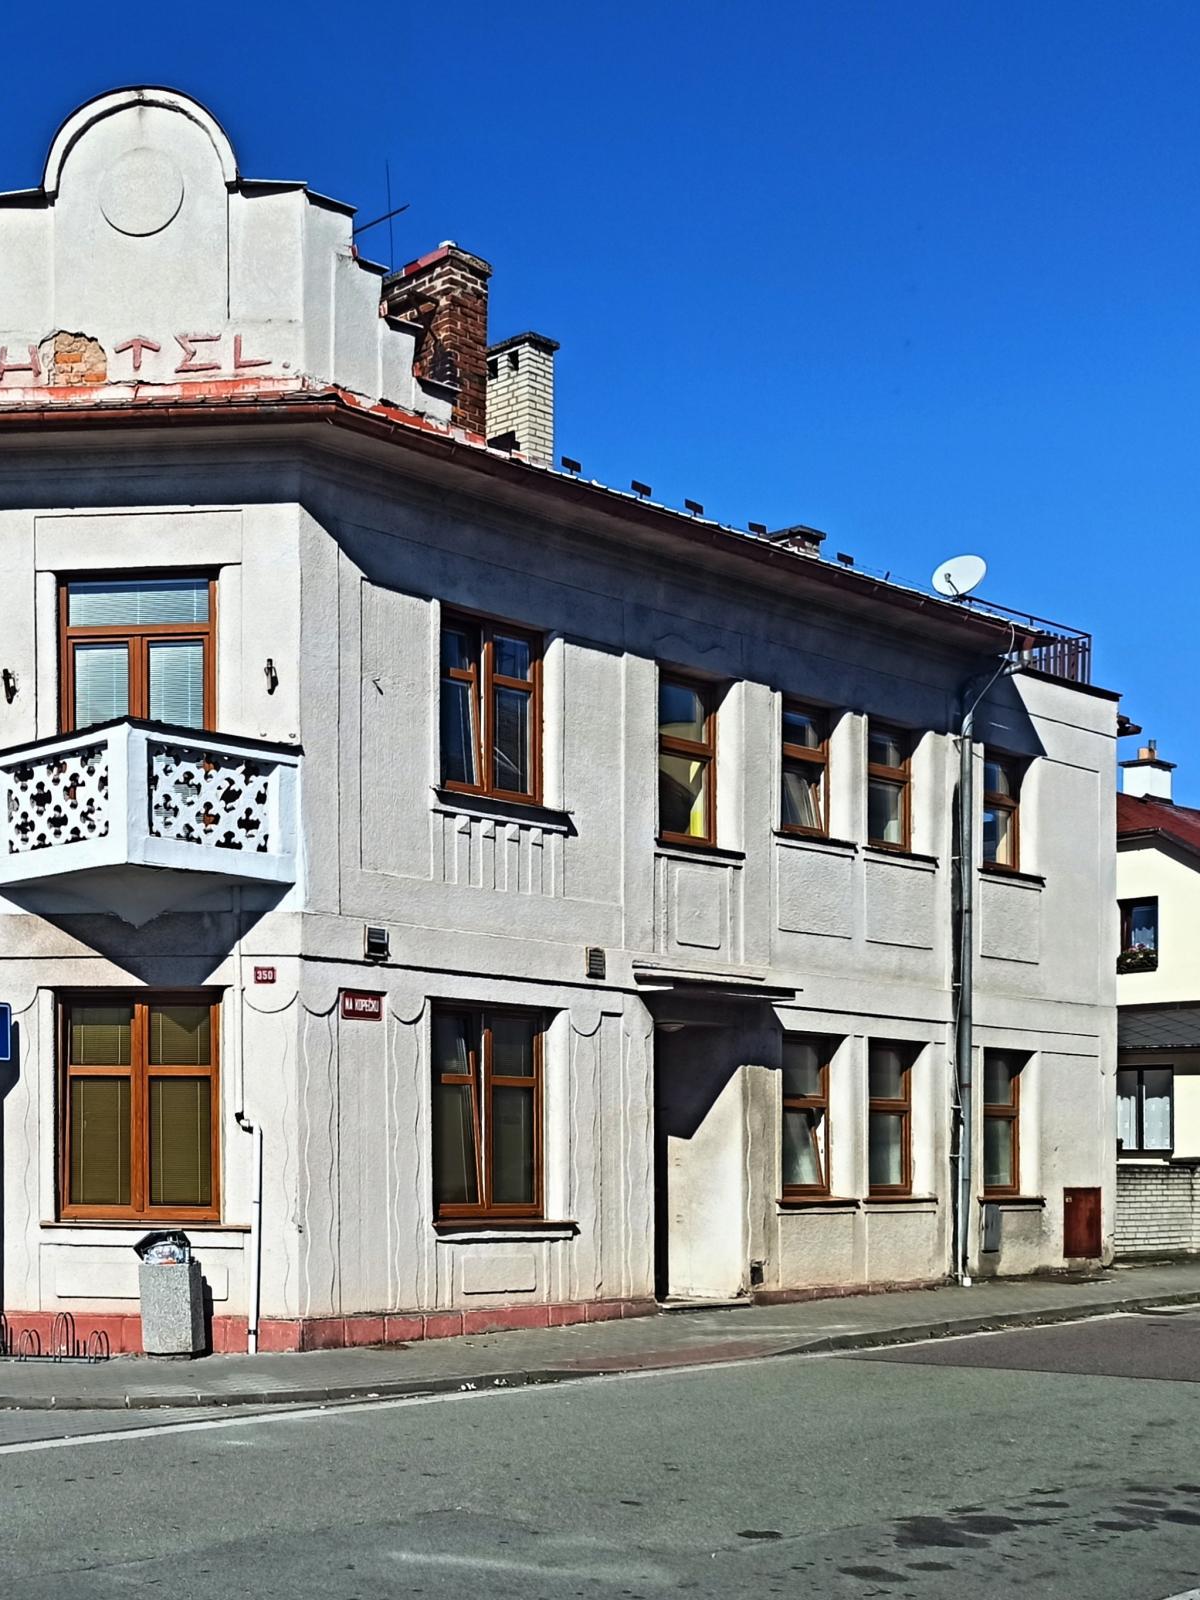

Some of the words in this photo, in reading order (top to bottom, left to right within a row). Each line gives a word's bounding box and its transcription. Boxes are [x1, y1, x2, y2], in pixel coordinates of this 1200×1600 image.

[256, 970, 273, 980] 350
[345, 998, 353, 1010] NA
[355, 997, 379, 1012] KOPEČKU
